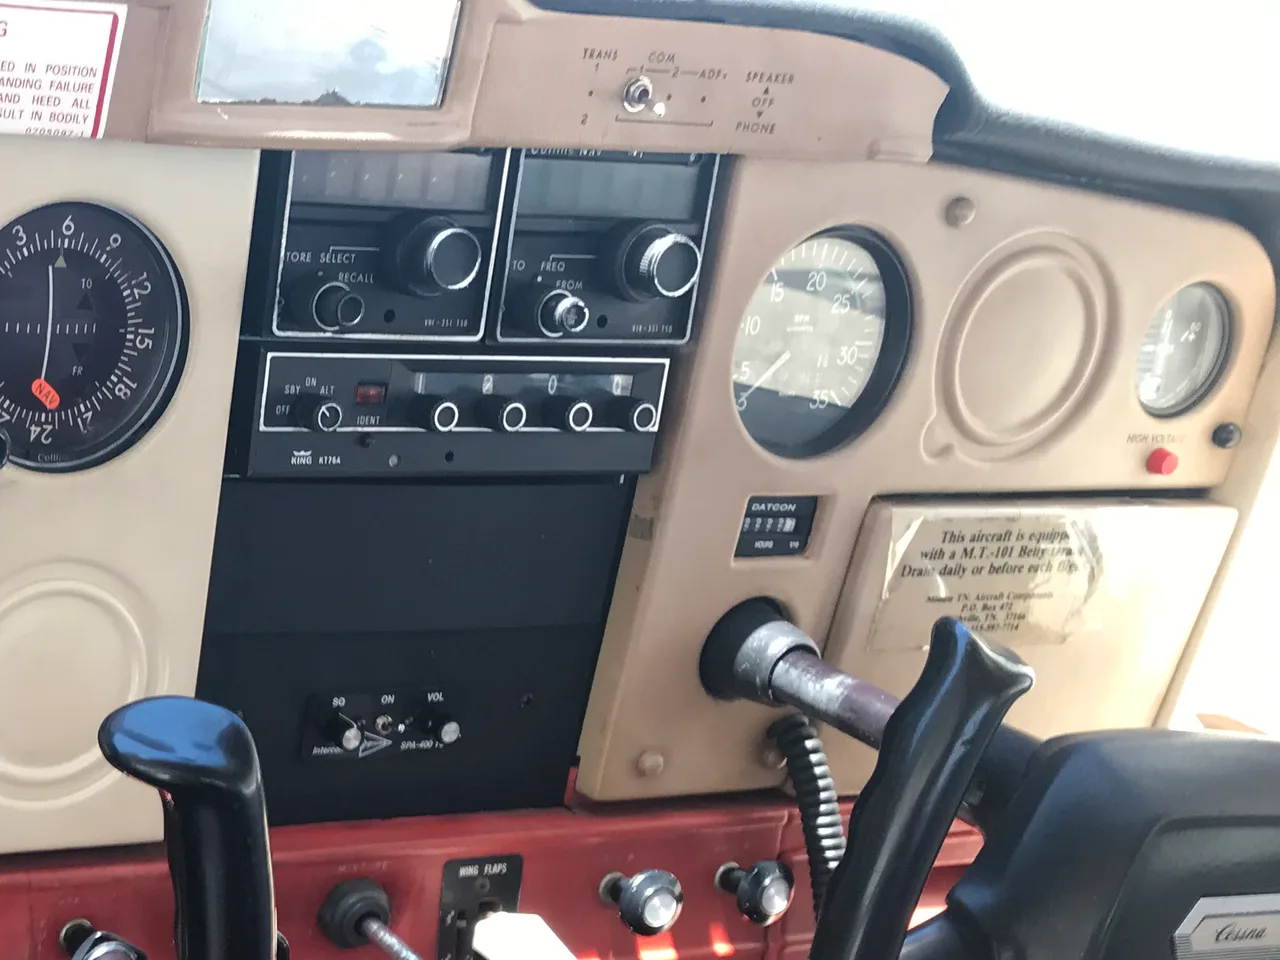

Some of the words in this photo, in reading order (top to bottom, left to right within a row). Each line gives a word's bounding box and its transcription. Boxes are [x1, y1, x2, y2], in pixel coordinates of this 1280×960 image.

[582, 48, 618, 61] TRANS
[648, 51, 676, 63] COM
[24, 62, 36, 74] IN
[45, 63, 98, 78] POSITION
[745, 72, 795, 84] SPEAKER
[49, 80, 95, 94] FAILURE
[31, 94, 61, 107] HEED
[71, 97, 90, 110] ALL
[751, 97, 775, 108] OFF
[30, 110, 43, 122] IN
[48, 111, 89, 125] BODILY
[735, 122, 776, 134] PHONE
[62, 214, 75, 236] 6
[12, 224, 27, 246] 3
[320, 252, 356, 264] SELECT
[540, 260, 565, 272] FREQ
[338, 271, 375, 284] RECALL
[806, 270, 827, 292] 20
[131, 271, 152, 300] 12
[770, 282, 784, 303] 15
[831, 293, 851, 314] 25
[744, 316, 761, 336] 10
[136, 326, 155, 350] 15
[836, 346, 858, 366] 30
[739, 360, 750, 381] 5
[114, 376, 138, 400] 18
[305, 377, 317, 387] ON
[320, 385, 335, 395] ALT
[809, 389, 829, 410] 35
[275, 405, 290, 415] OFF
[357, 415, 380, 425] IDENT
[29, 424, 53, 445] 24
[291, 455, 312, 465] KING
[752, 503, 797, 512] DATCON
[941, 530, 966, 544] This
[969, 529, 1013, 544] aircraft
[1015, 531, 1025, 542] is
[920, 548, 946, 561] with
[938, 563, 968, 579] daily
[971, 565, 984, 576] or
[988, 562, 1025, 575] before
[1027, 561, 1053, 574] each
[381, 694, 395, 706] ON
[427, 691, 444, 703] VOL
[459, 866, 479, 878] WING
[483, 862, 507, 876] FLAPS
[1214, 921, 1268, 944] Cessna
